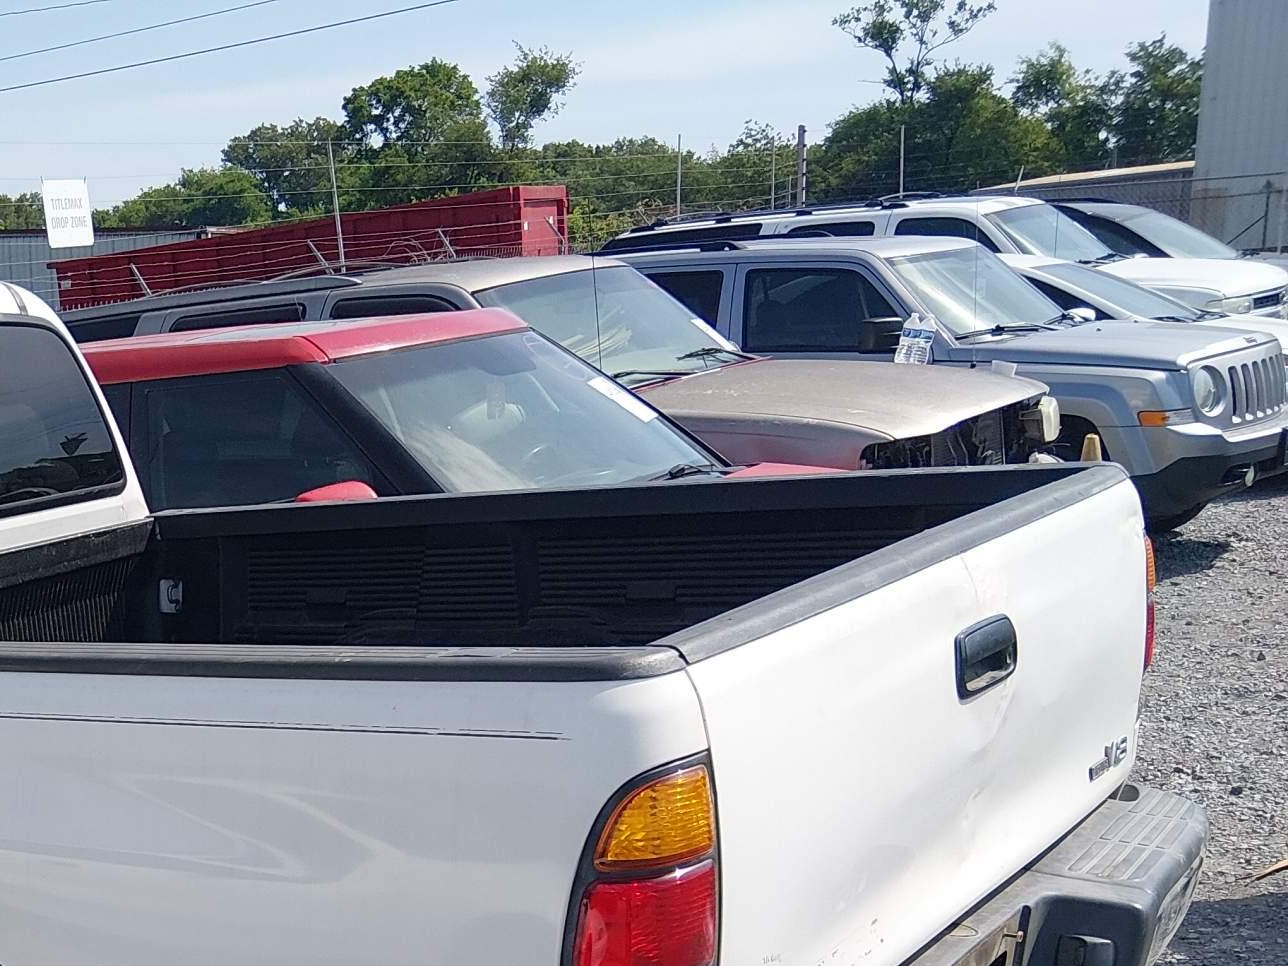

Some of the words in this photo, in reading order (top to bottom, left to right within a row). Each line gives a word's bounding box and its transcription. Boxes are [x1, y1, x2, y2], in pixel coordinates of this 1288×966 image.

[50, 198, 83, 211] TITLEMAX
[51, 216, 69, 230] DROP
[70, 215, 88, 228] ZONE
